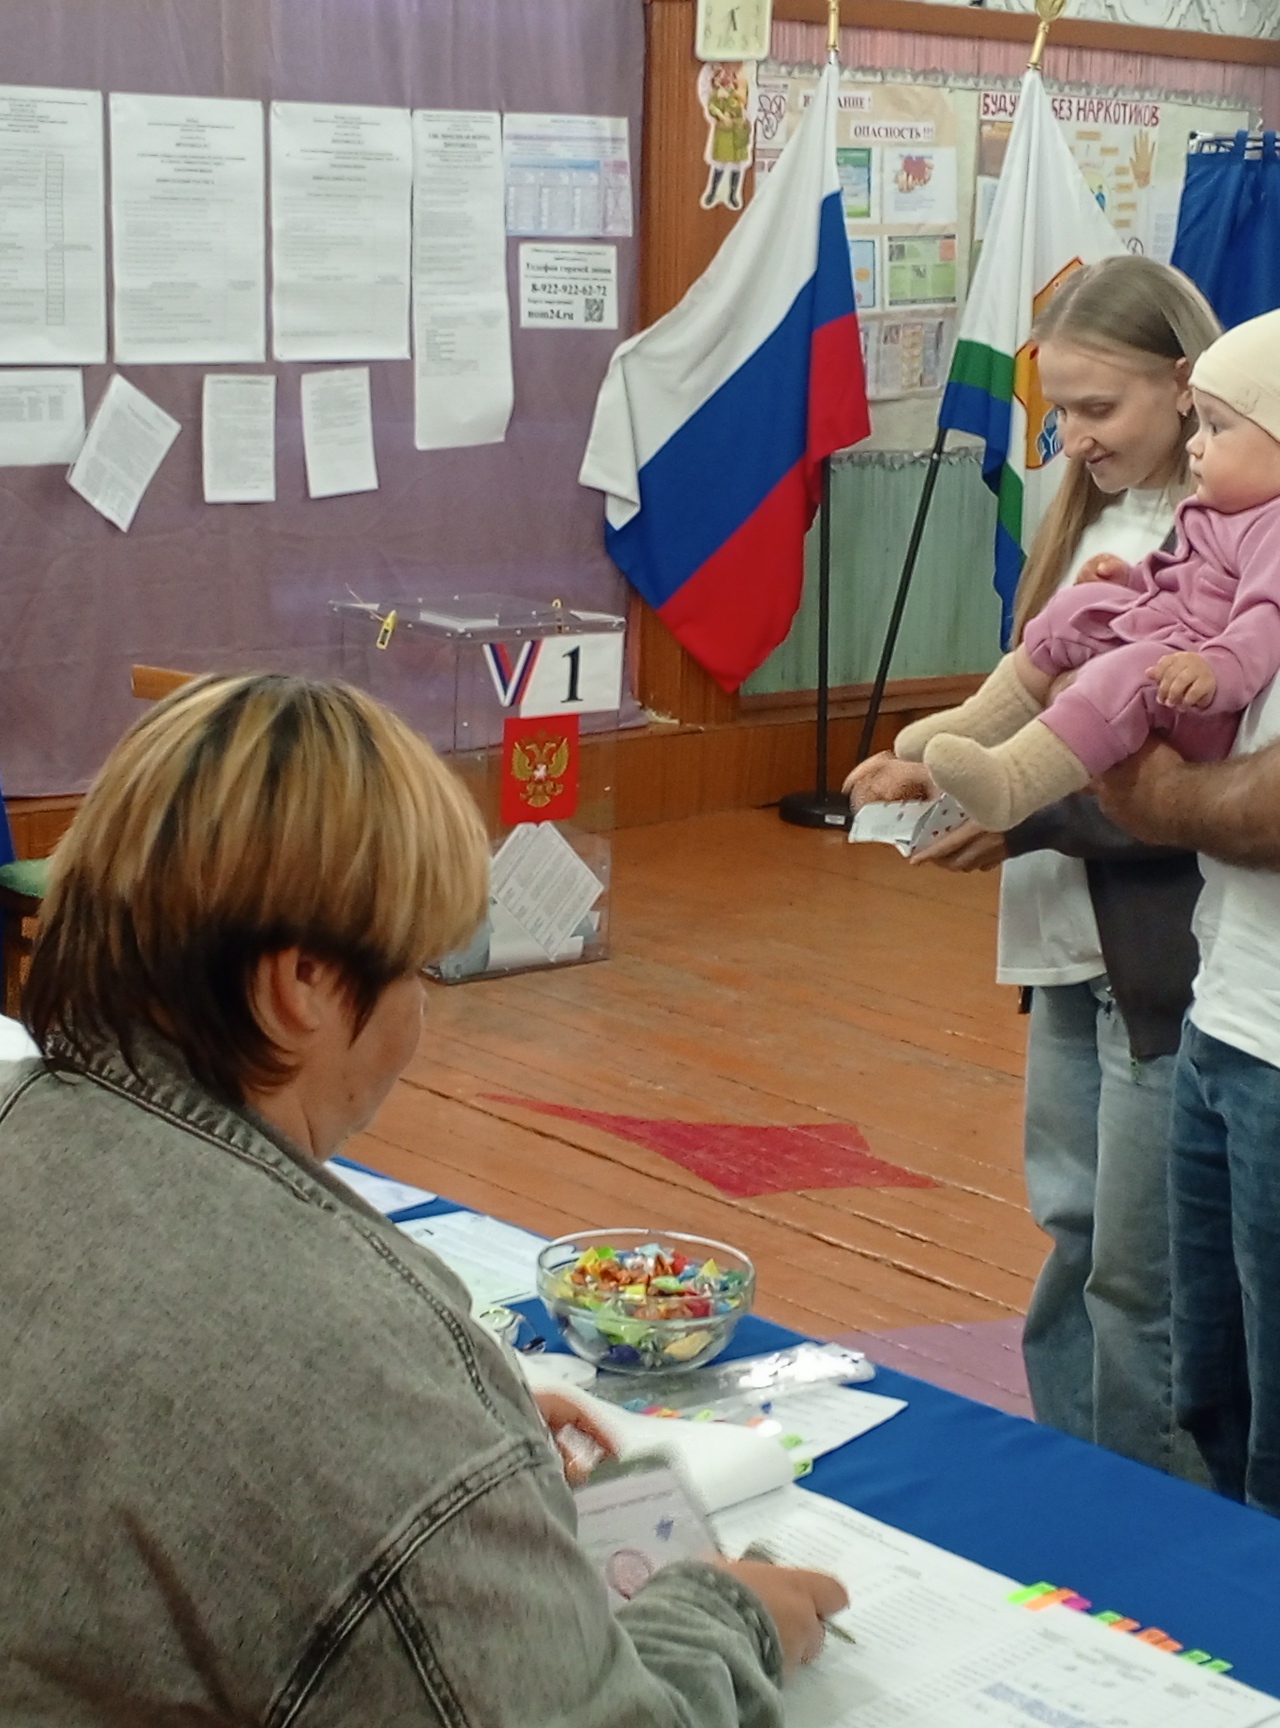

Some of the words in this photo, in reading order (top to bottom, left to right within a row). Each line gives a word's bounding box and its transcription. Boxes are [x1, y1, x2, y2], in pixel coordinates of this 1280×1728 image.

[982, 92, 1020, 117] БУДУ
[1051, 97, 1073, 121] БЕЗ
[1076, 99, 1160, 127] НАРКОТИКОВ
[854, 125, 921, 140] ОПАСНОСТЬ
[560, 645, 584, 704] 1
